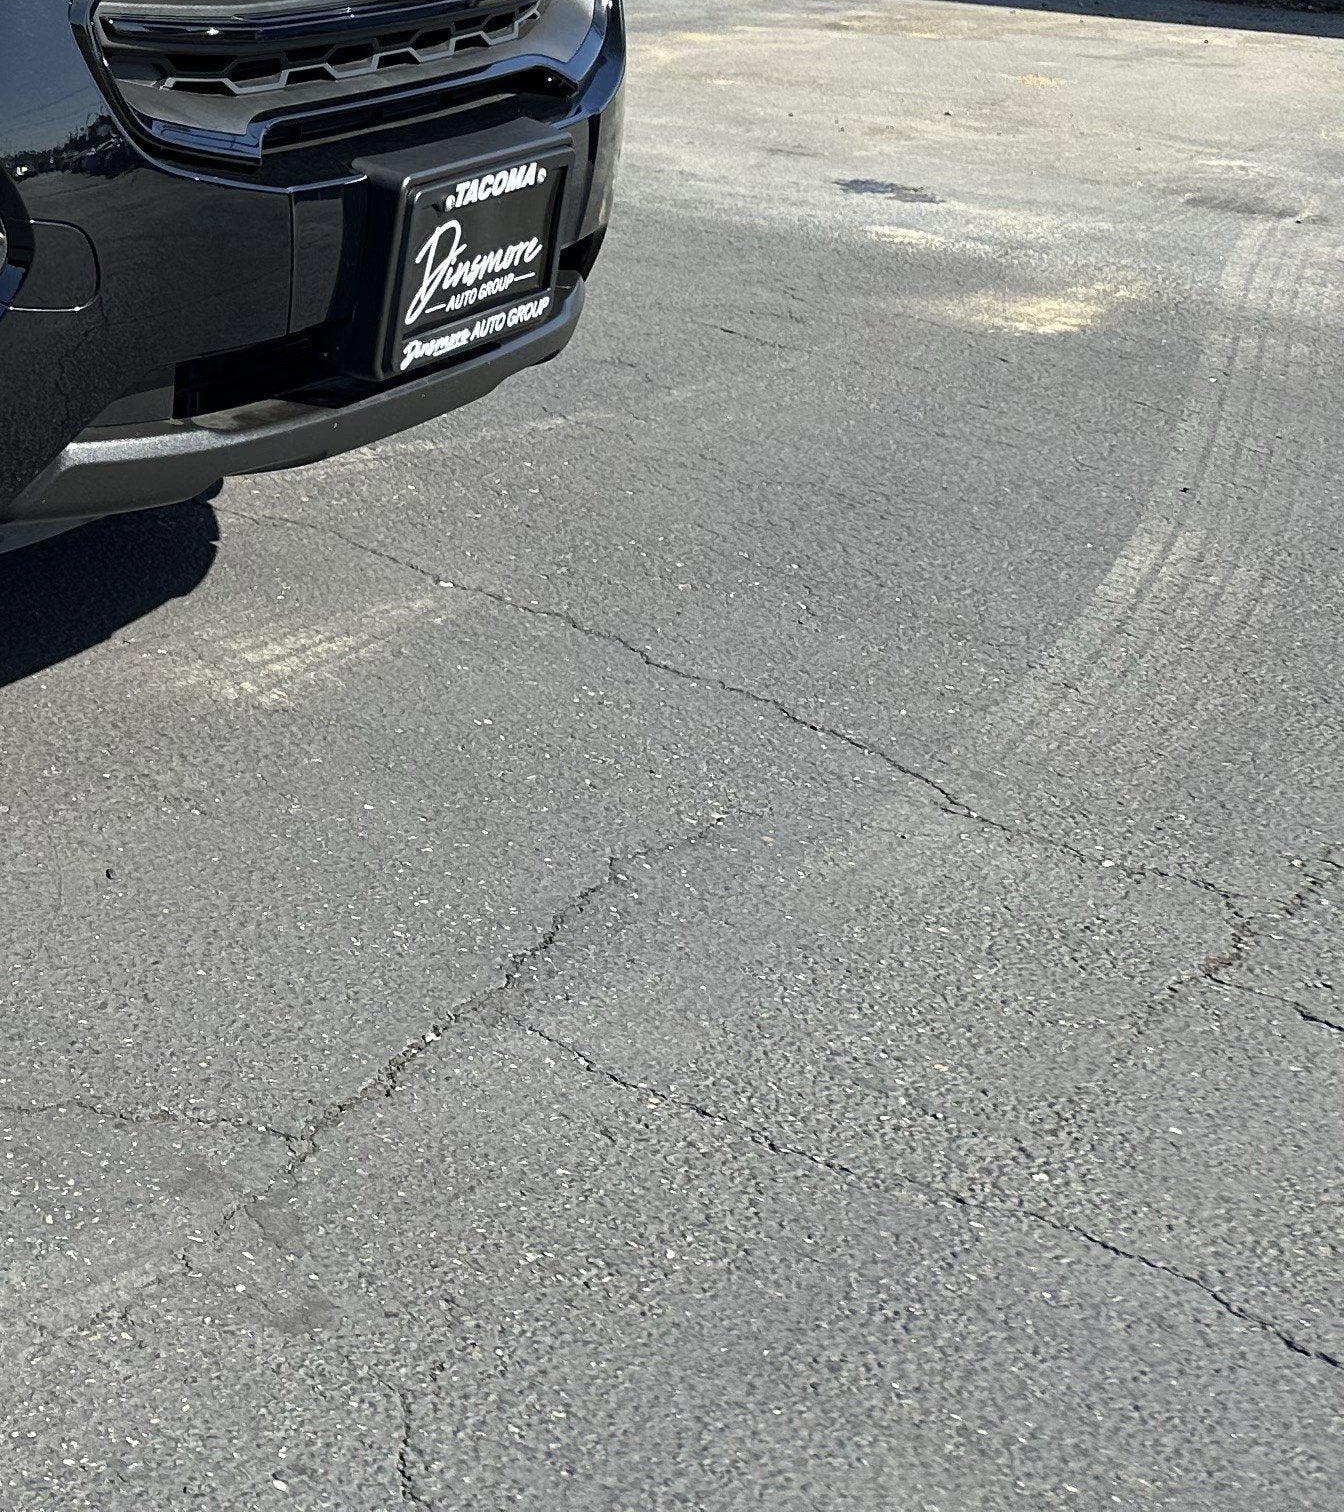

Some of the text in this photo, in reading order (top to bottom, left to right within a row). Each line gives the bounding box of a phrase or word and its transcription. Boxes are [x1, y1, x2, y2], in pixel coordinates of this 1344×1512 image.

[454, 162, 538, 208] TACOMA
[404, 219, 543, 325] Dinsmore
[445, 273, 514, 312] AUTO GROUP
[470, 312, 507, 341] AUTO
[507, 296, 550, 327] GROUP
